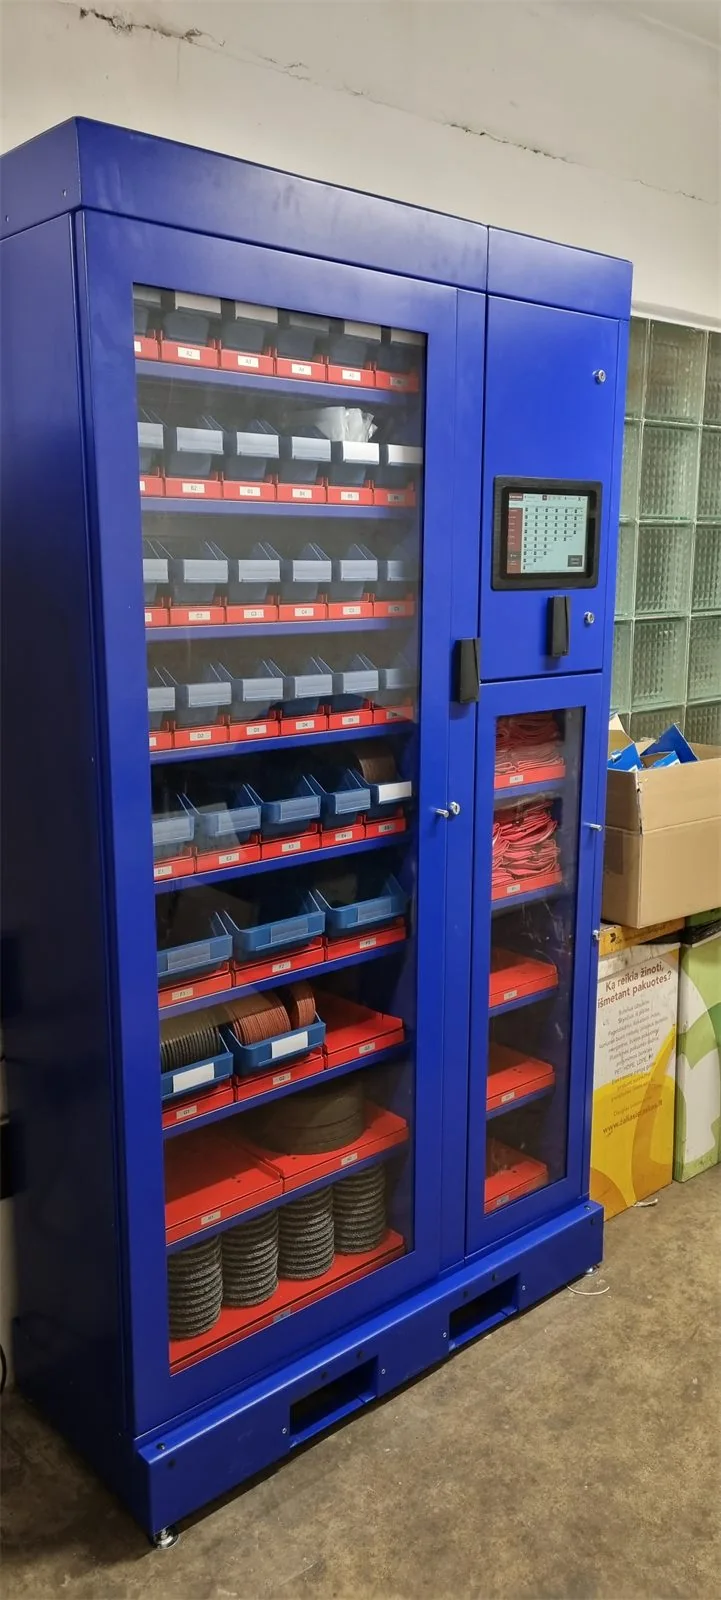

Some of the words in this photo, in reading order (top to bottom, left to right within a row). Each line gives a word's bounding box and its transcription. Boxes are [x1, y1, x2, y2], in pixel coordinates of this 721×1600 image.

[597, 987, 631, 1009] išmetant
[632, 970, 672, 997] pakuotes?
[605, 981, 616, 992] Ką
[617, 970, 639, 987] reikia
[640, 961, 664, 978] žinoti,
